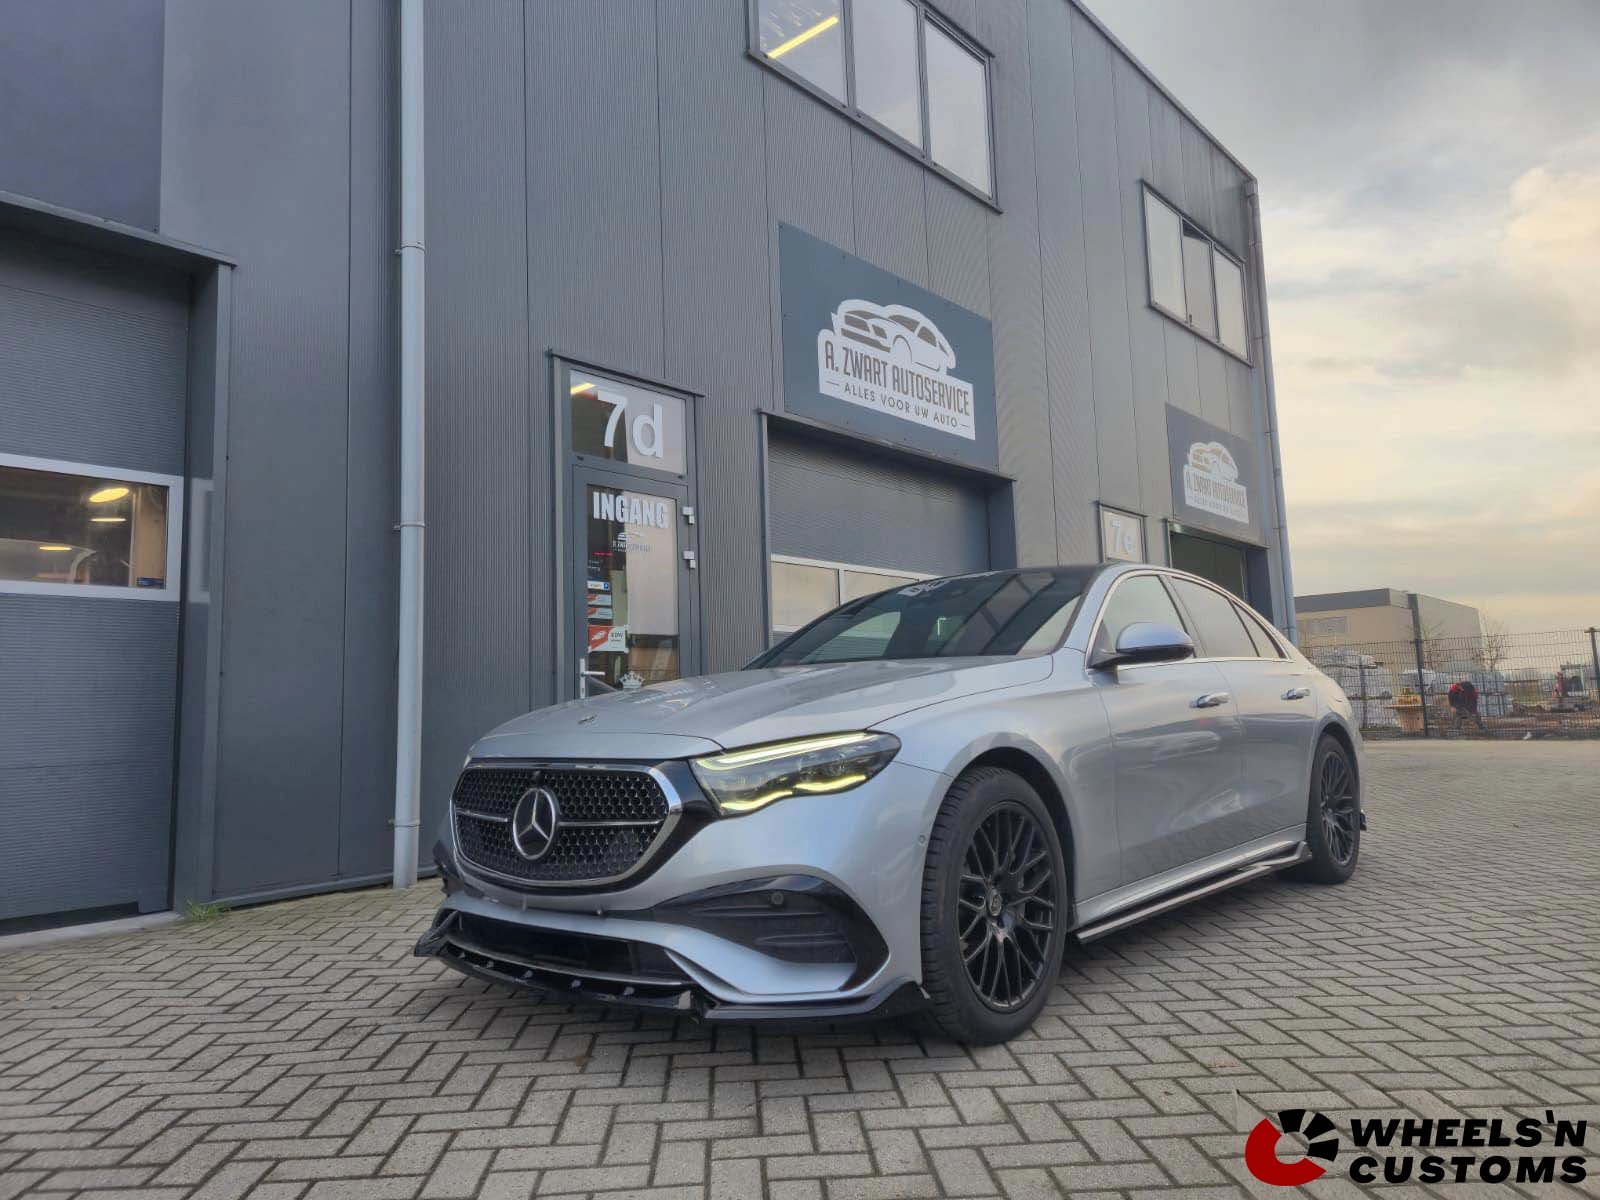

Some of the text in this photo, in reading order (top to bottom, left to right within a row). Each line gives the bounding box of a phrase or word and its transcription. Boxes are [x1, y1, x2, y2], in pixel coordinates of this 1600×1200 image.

[824, 340, 970, 417] A. ZWART AUTOSERVICE
[844, 382, 958, 428] ALLES VOOR UW AUTO
[597, 390, 664, 459] 7d
[593, 491, 669, 528] INGANG
